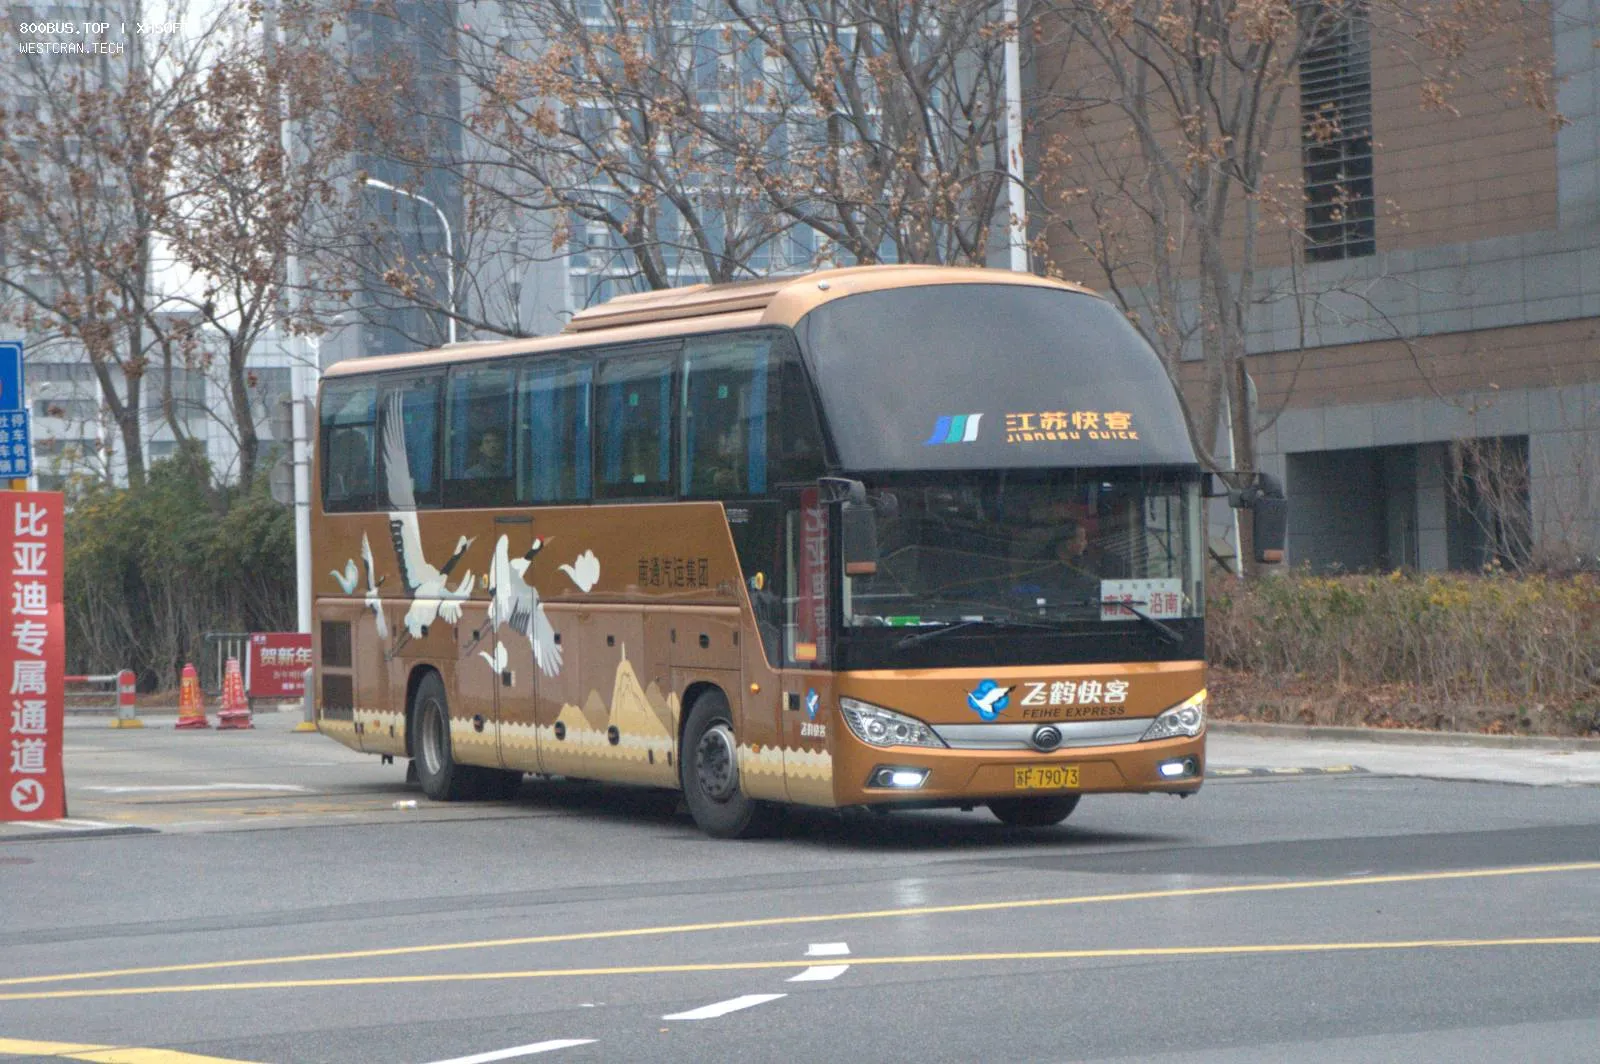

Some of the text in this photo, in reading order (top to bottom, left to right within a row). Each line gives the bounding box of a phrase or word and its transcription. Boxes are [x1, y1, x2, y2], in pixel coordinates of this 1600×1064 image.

[1005, 411, 1134, 431] 江苏快客
[10, 502, 48, 774] 比亚迪专属通道
[1020, 680, 1130, 706] 飞鹤快客
[1023, 706, 1126, 719] FEIHE EXPRESS
